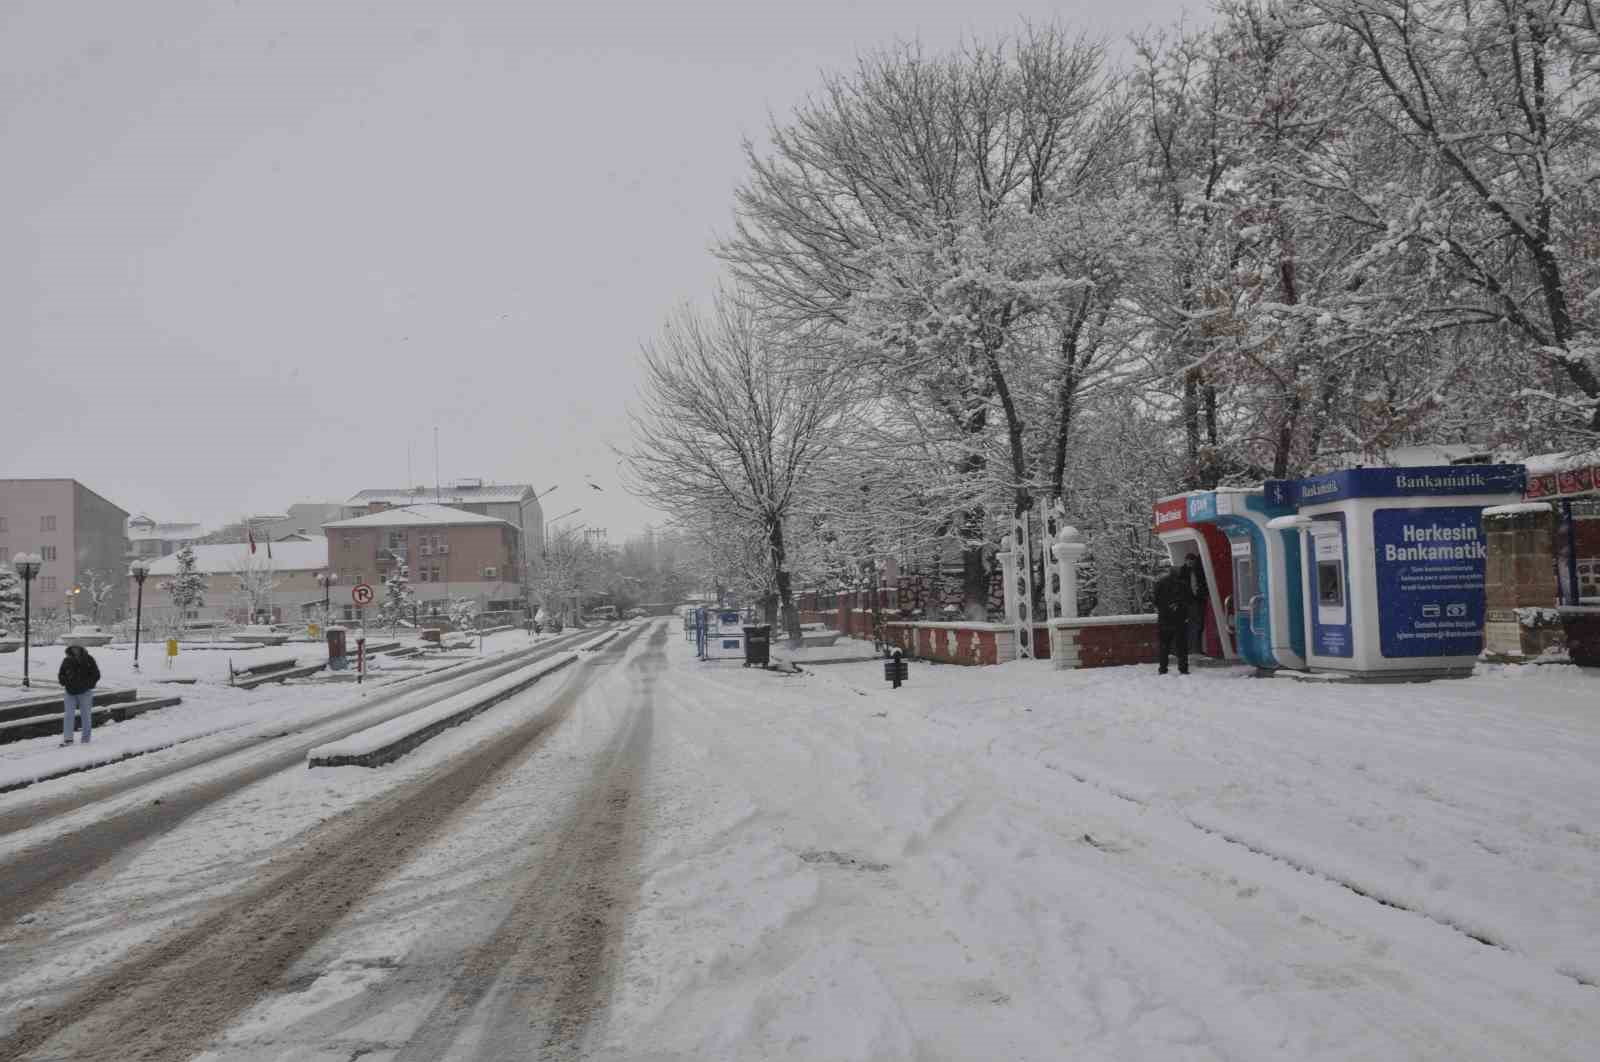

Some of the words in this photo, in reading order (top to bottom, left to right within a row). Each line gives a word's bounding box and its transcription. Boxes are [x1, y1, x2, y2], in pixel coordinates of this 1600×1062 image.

[1395, 473, 1486, 489] Bankamatik
[1403, 523, 1478, 542] Herkesin
[1385, 541, 1487, 561] Bankamatik
